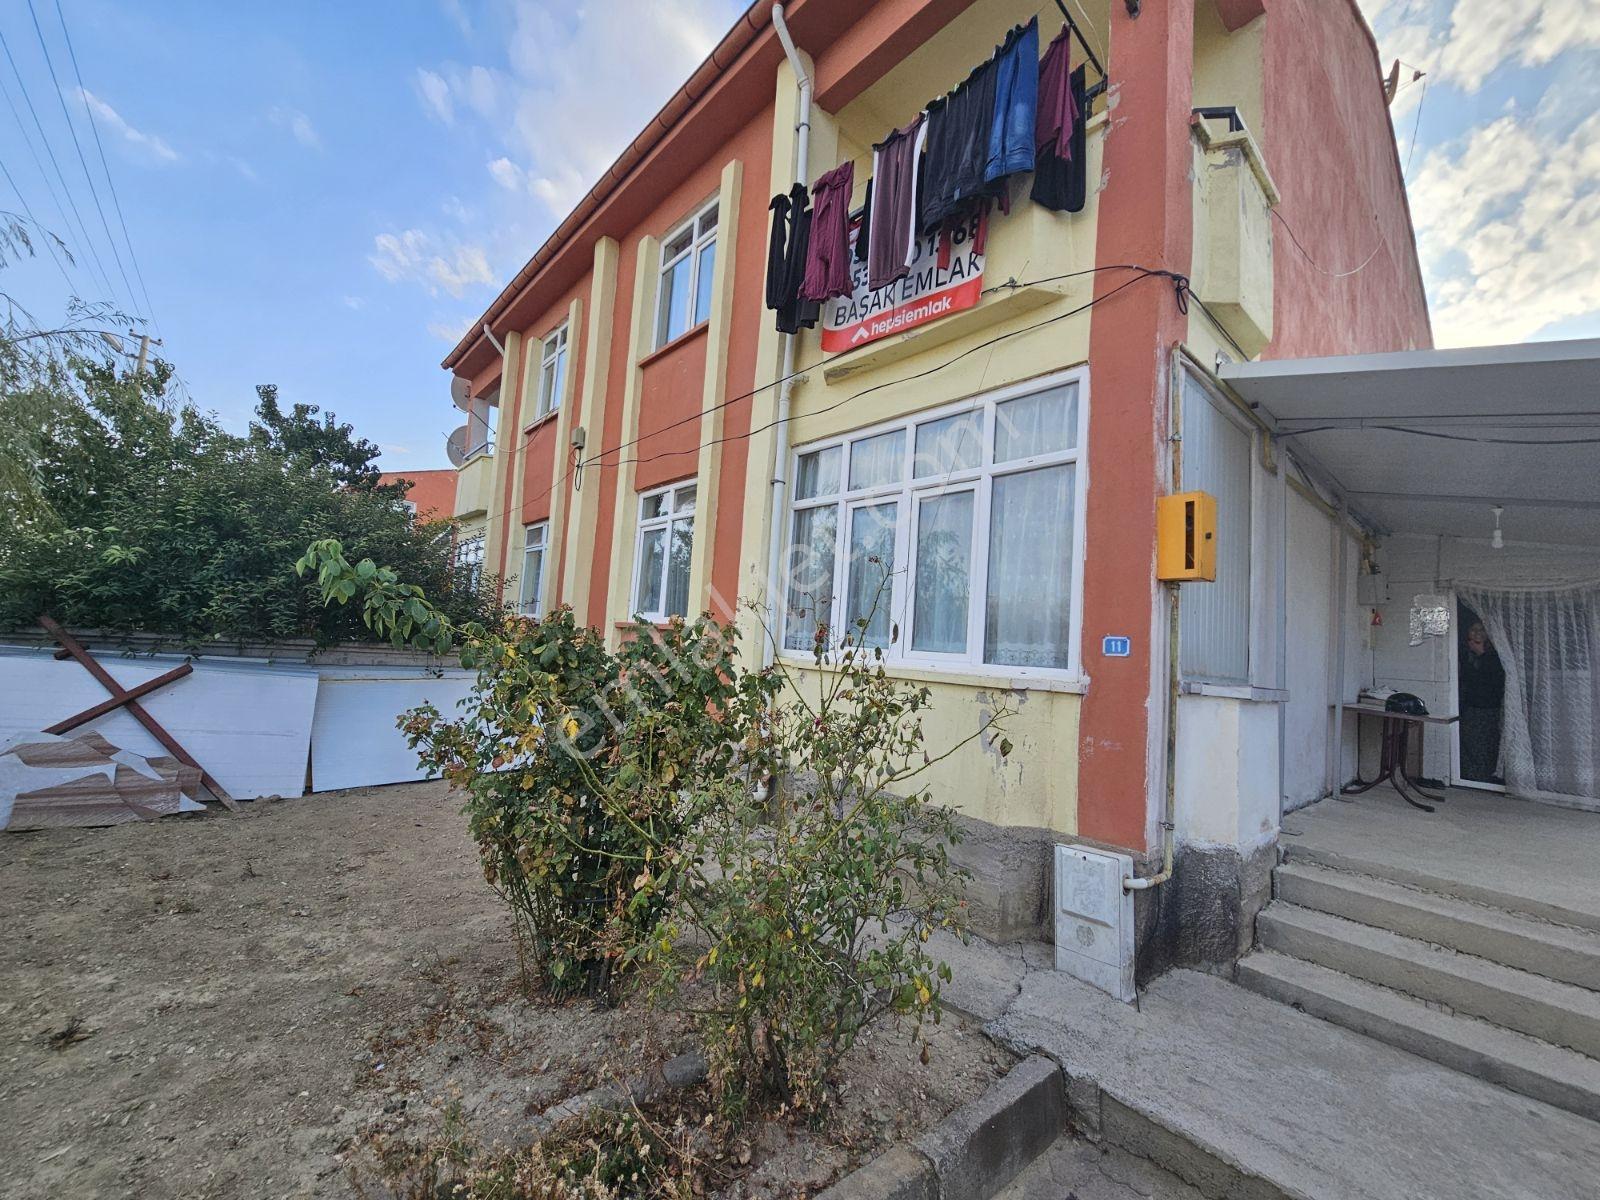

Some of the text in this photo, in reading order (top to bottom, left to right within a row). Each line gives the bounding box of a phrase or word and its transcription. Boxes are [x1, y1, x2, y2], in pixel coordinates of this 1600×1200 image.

[834, 281, 897, 327] BAŞAK
[902, 252, 981, 300] EMLAK
[871, 296, 953, 335] hepsiemlak
[1111, 640, 1121, 652] 11
